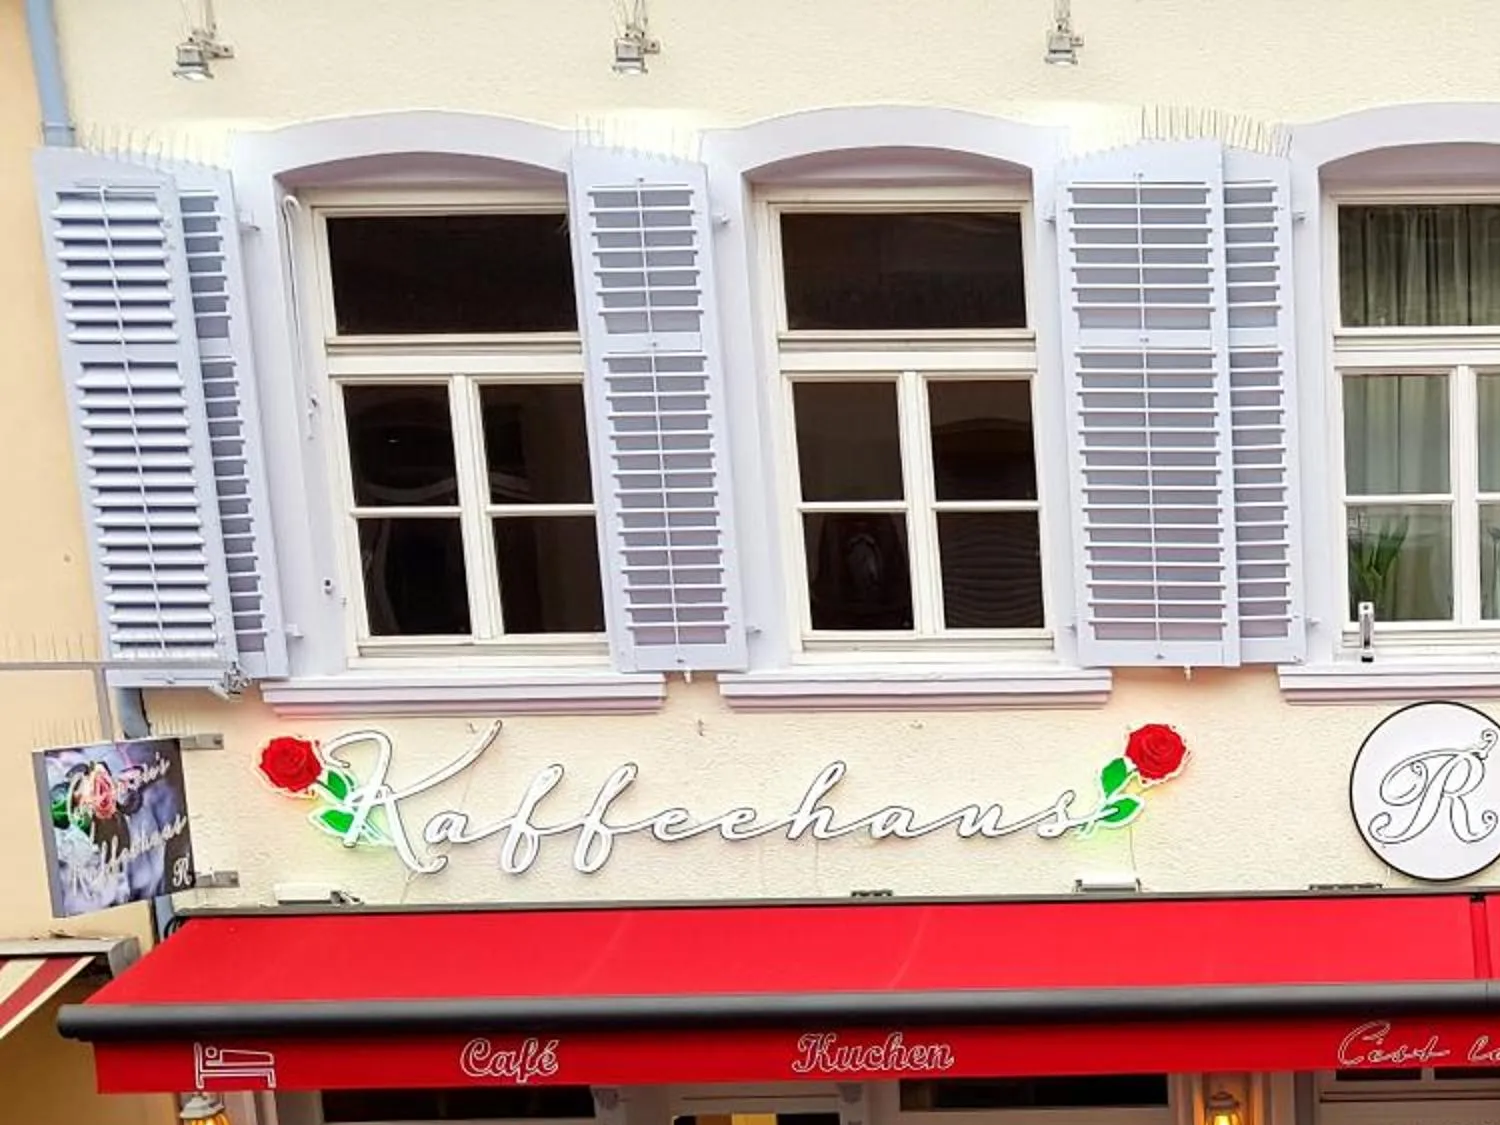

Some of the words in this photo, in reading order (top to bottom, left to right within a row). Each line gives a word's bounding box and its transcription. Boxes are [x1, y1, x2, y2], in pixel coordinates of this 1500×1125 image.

[322, 719, 1100, 875] Kaffeehaus
[1367, 727, 1499, 846] R
[460, 1037, 561, 1083] Café
[792, 1031, 955, 1073] Kuchen
[1338, 1020, 1451, 1065] C'est
